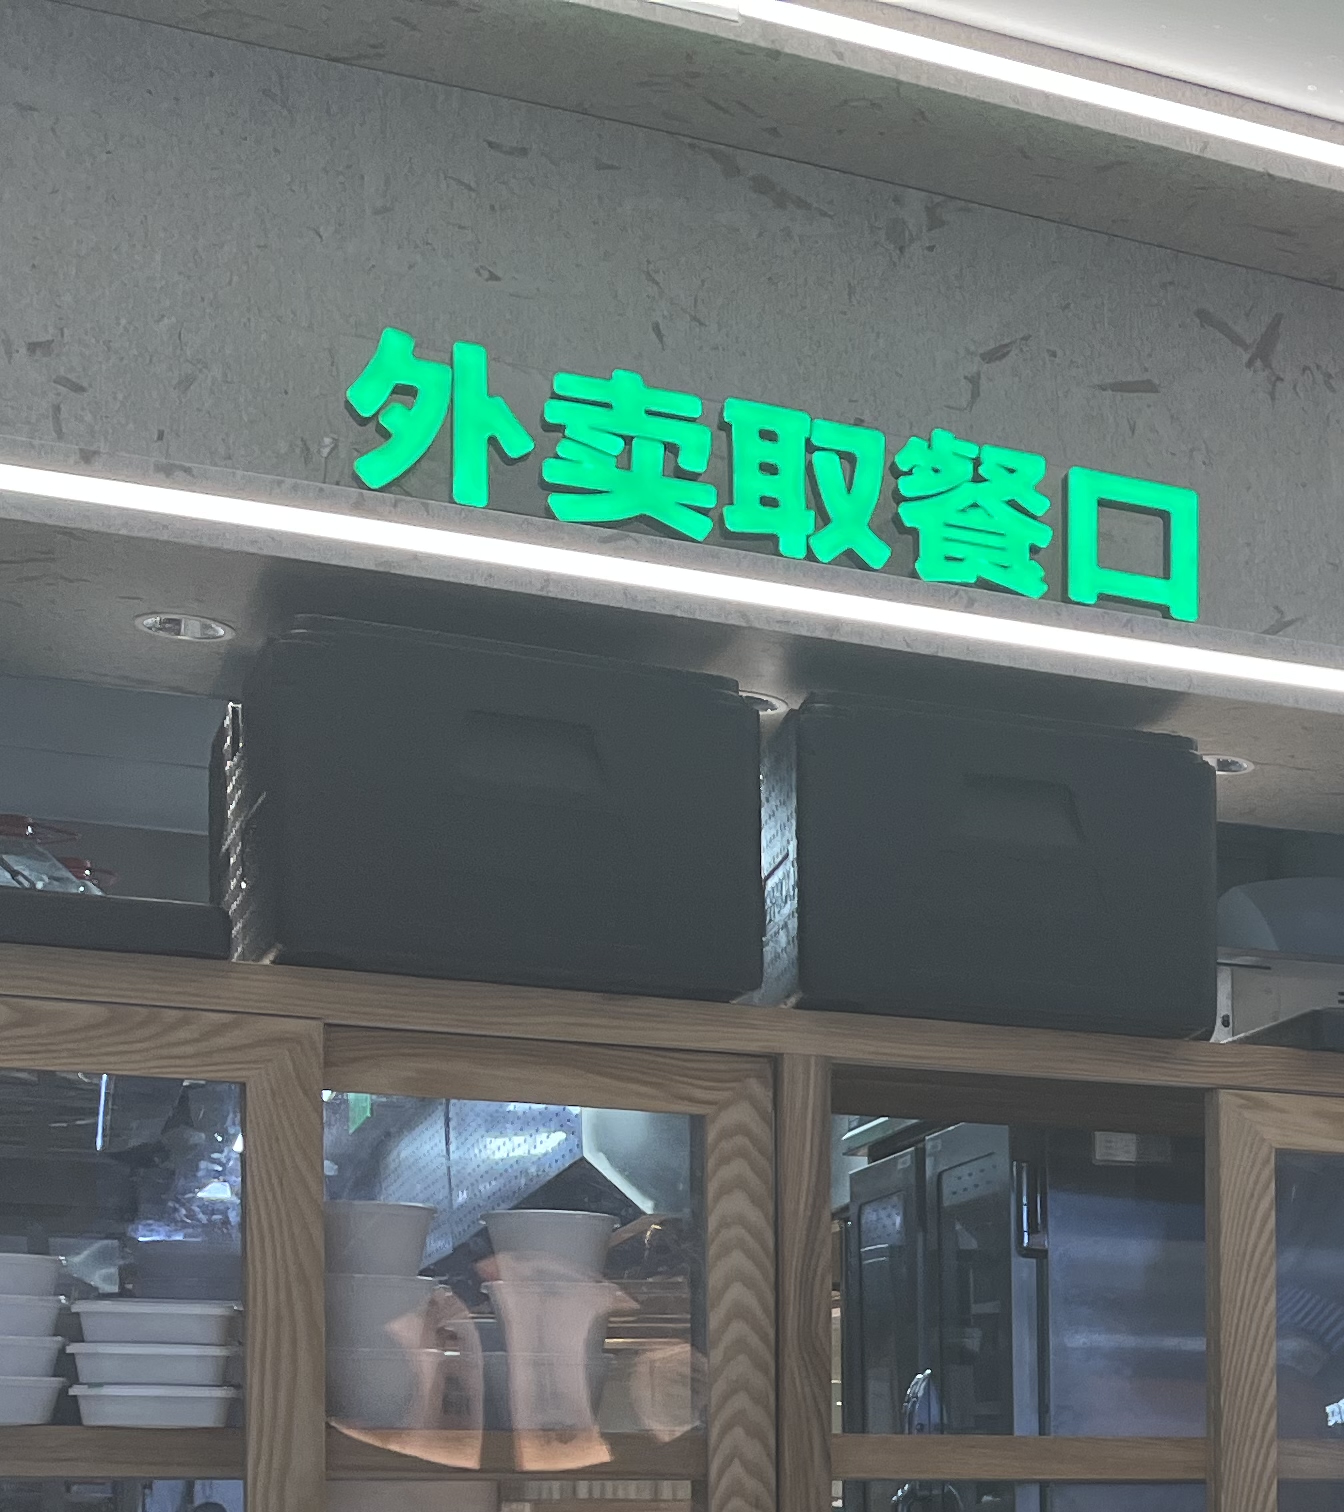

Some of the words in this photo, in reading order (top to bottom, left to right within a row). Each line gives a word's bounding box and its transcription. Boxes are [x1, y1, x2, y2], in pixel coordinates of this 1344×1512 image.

[347, 328, 1199, 622] 外卖取餐口
